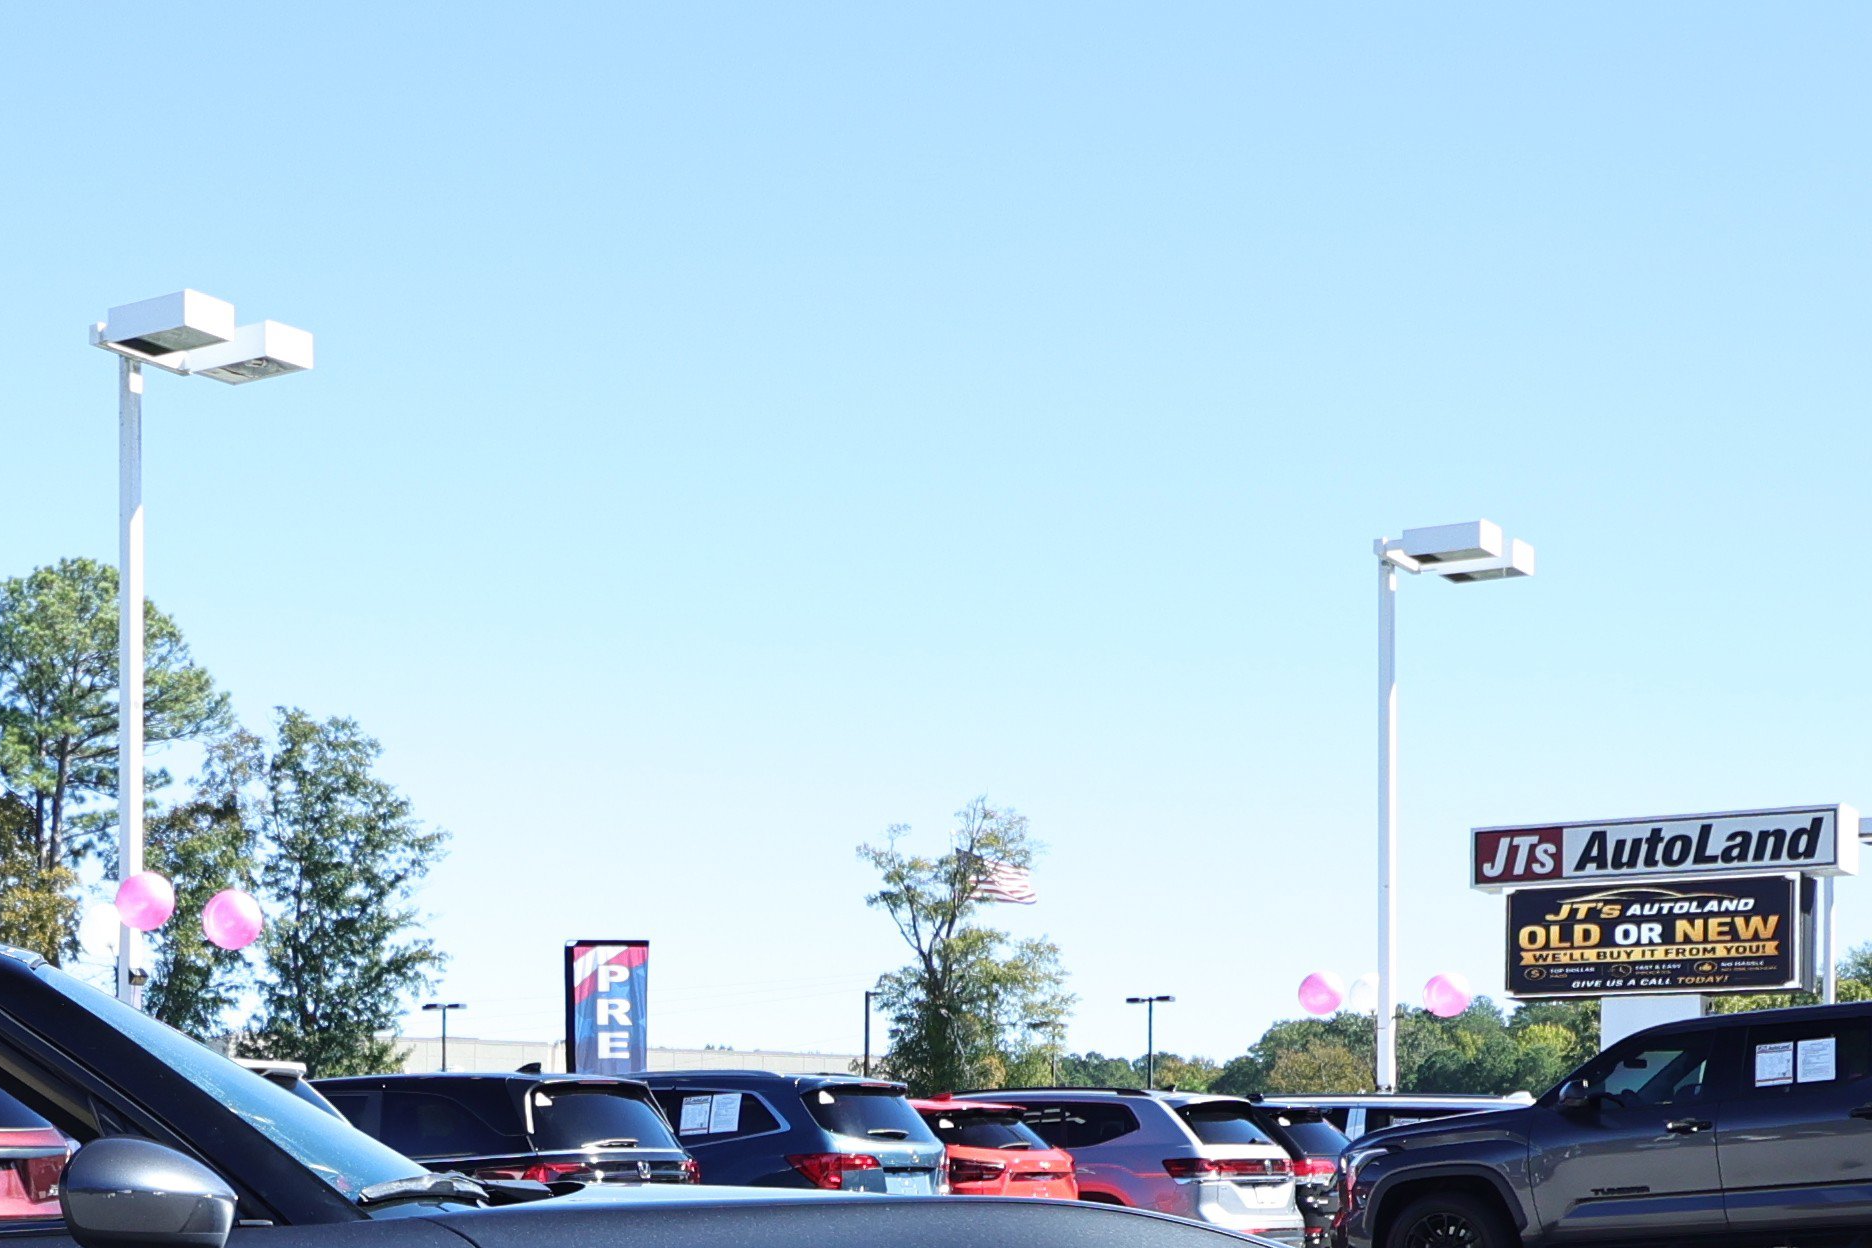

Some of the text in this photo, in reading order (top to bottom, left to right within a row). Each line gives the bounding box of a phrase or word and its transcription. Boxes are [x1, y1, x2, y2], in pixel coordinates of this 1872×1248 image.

[1482, 816, 1824, 878] JTs AutoLand
[1544, 898, 1755, 921] JT's AUTOLAND
[1518, 914, 1780, 950] OLD OR NEW
[1532, 943, 1766, 963] WE'LL BUY IT FROM YOU!
[1571, 980, 1602, 989] GIVE
[1606, 979, 1624, 988] US
[1626, 978, 1636, 987] A
[1640, 977, 1672, 987] CALL
[596, 963, 633, 1060] PRE
